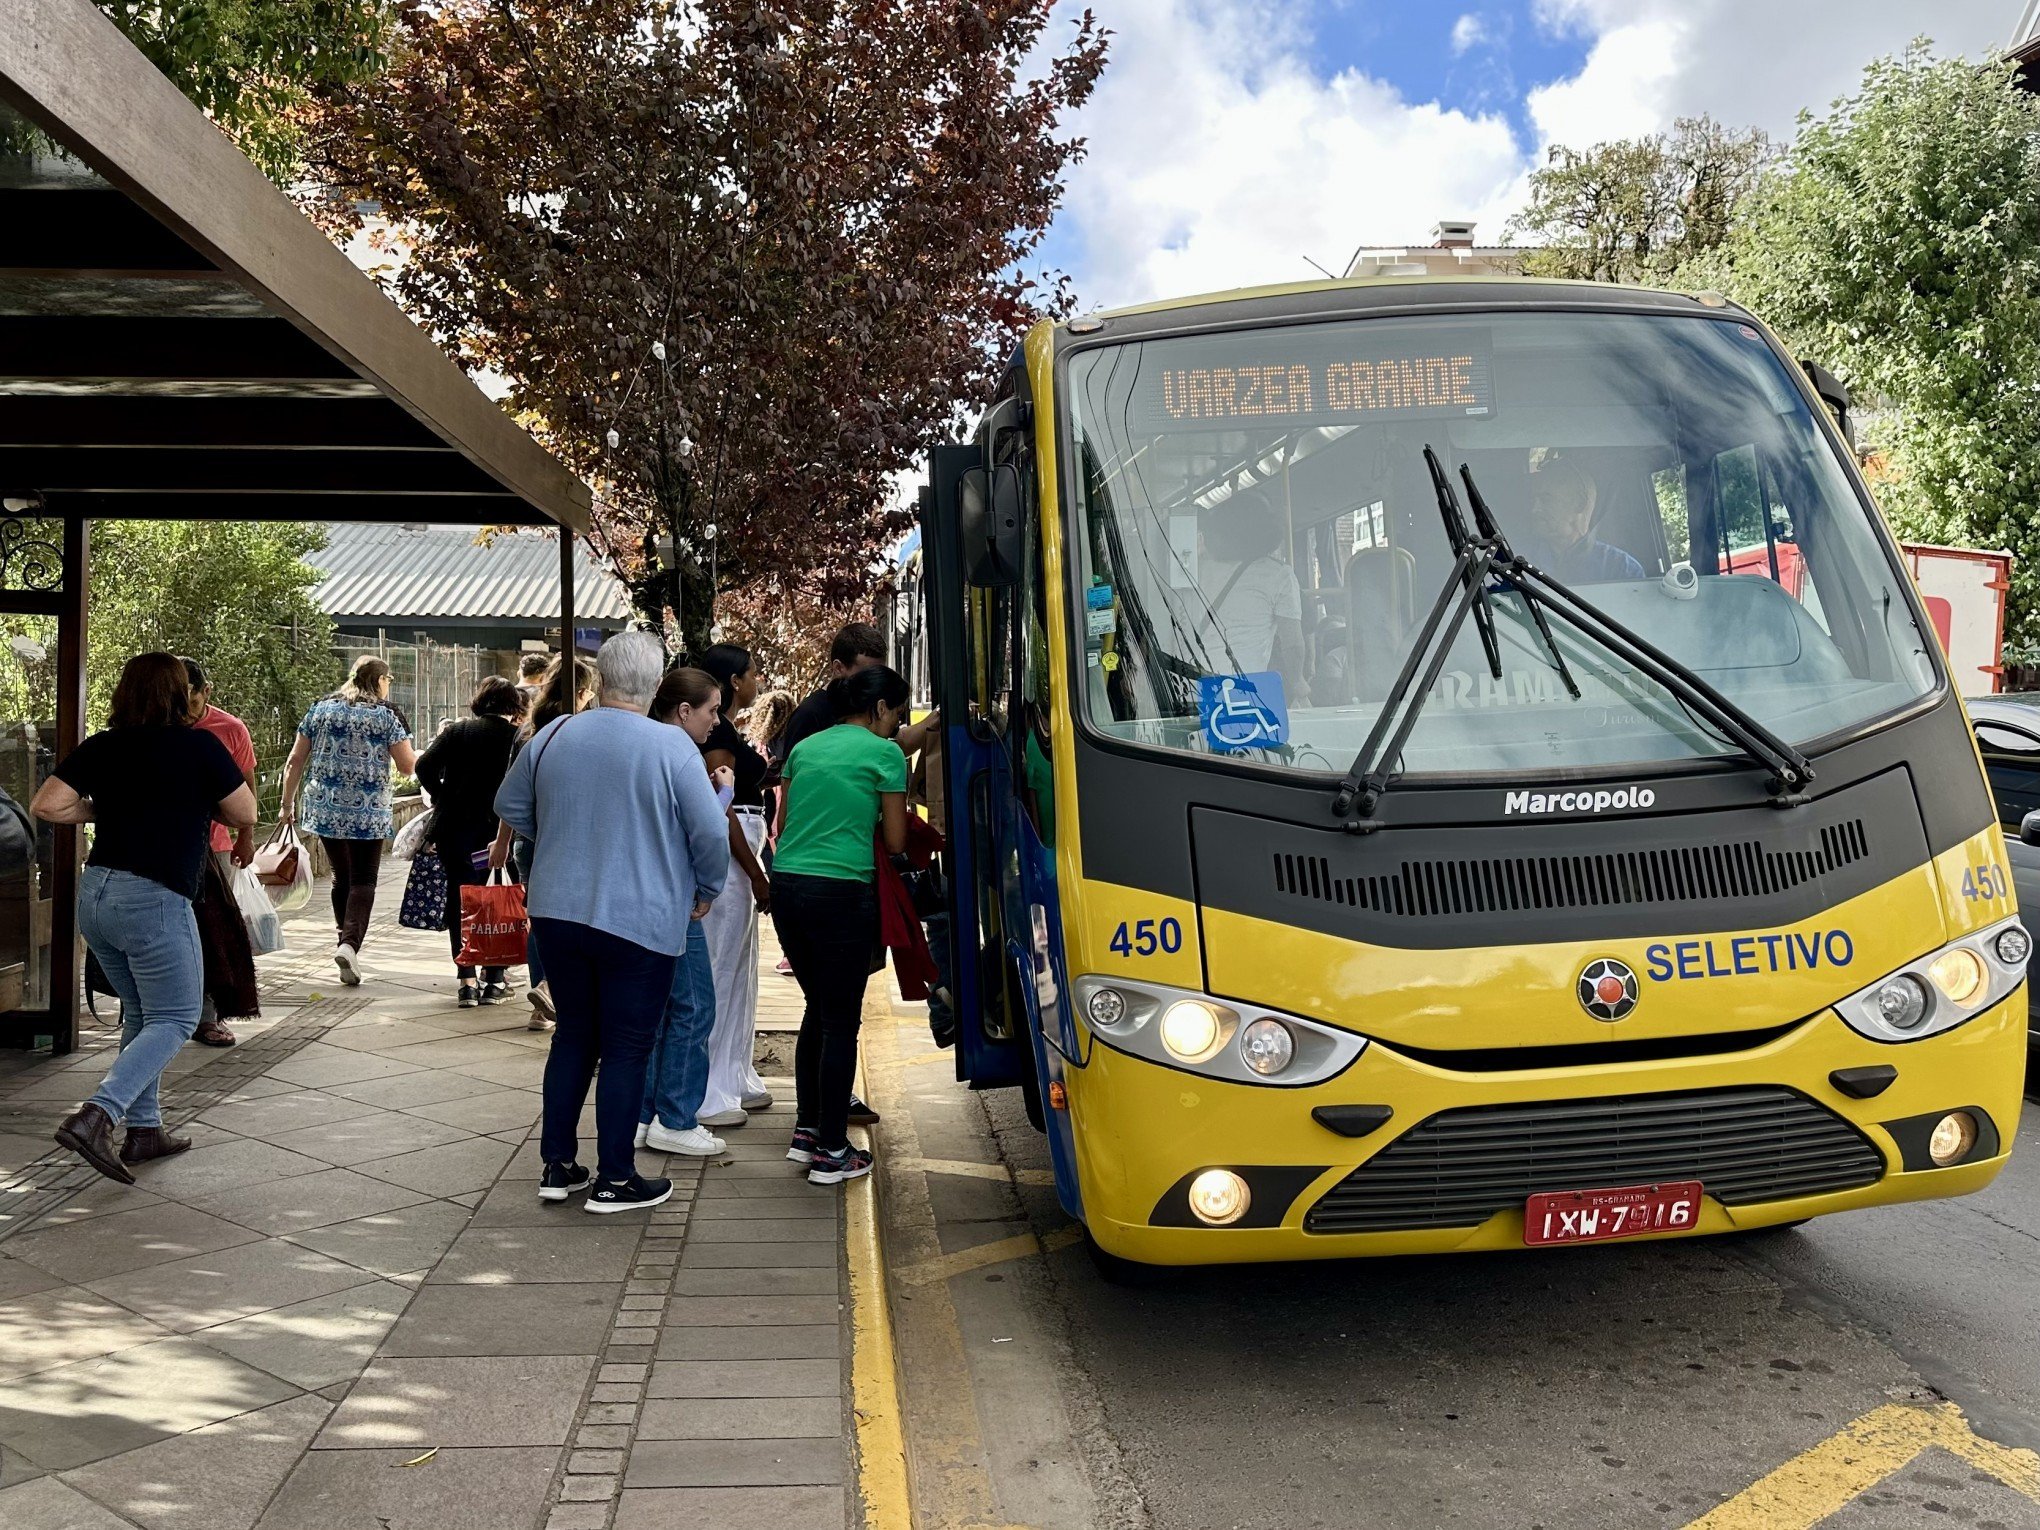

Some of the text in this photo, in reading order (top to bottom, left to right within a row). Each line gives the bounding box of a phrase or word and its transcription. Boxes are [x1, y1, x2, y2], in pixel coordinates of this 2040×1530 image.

[1162, 355, 1476, 418] VARZEA GRANDE
[1504, 786, 1655, 815] Marcopolo
[1961, 863, 2007, 902] 450
[469, 922, 515, 935] PARADA
[1109, 917, 1182, 957] 450
[1645, 929, 1854, 983] SELETIVO
